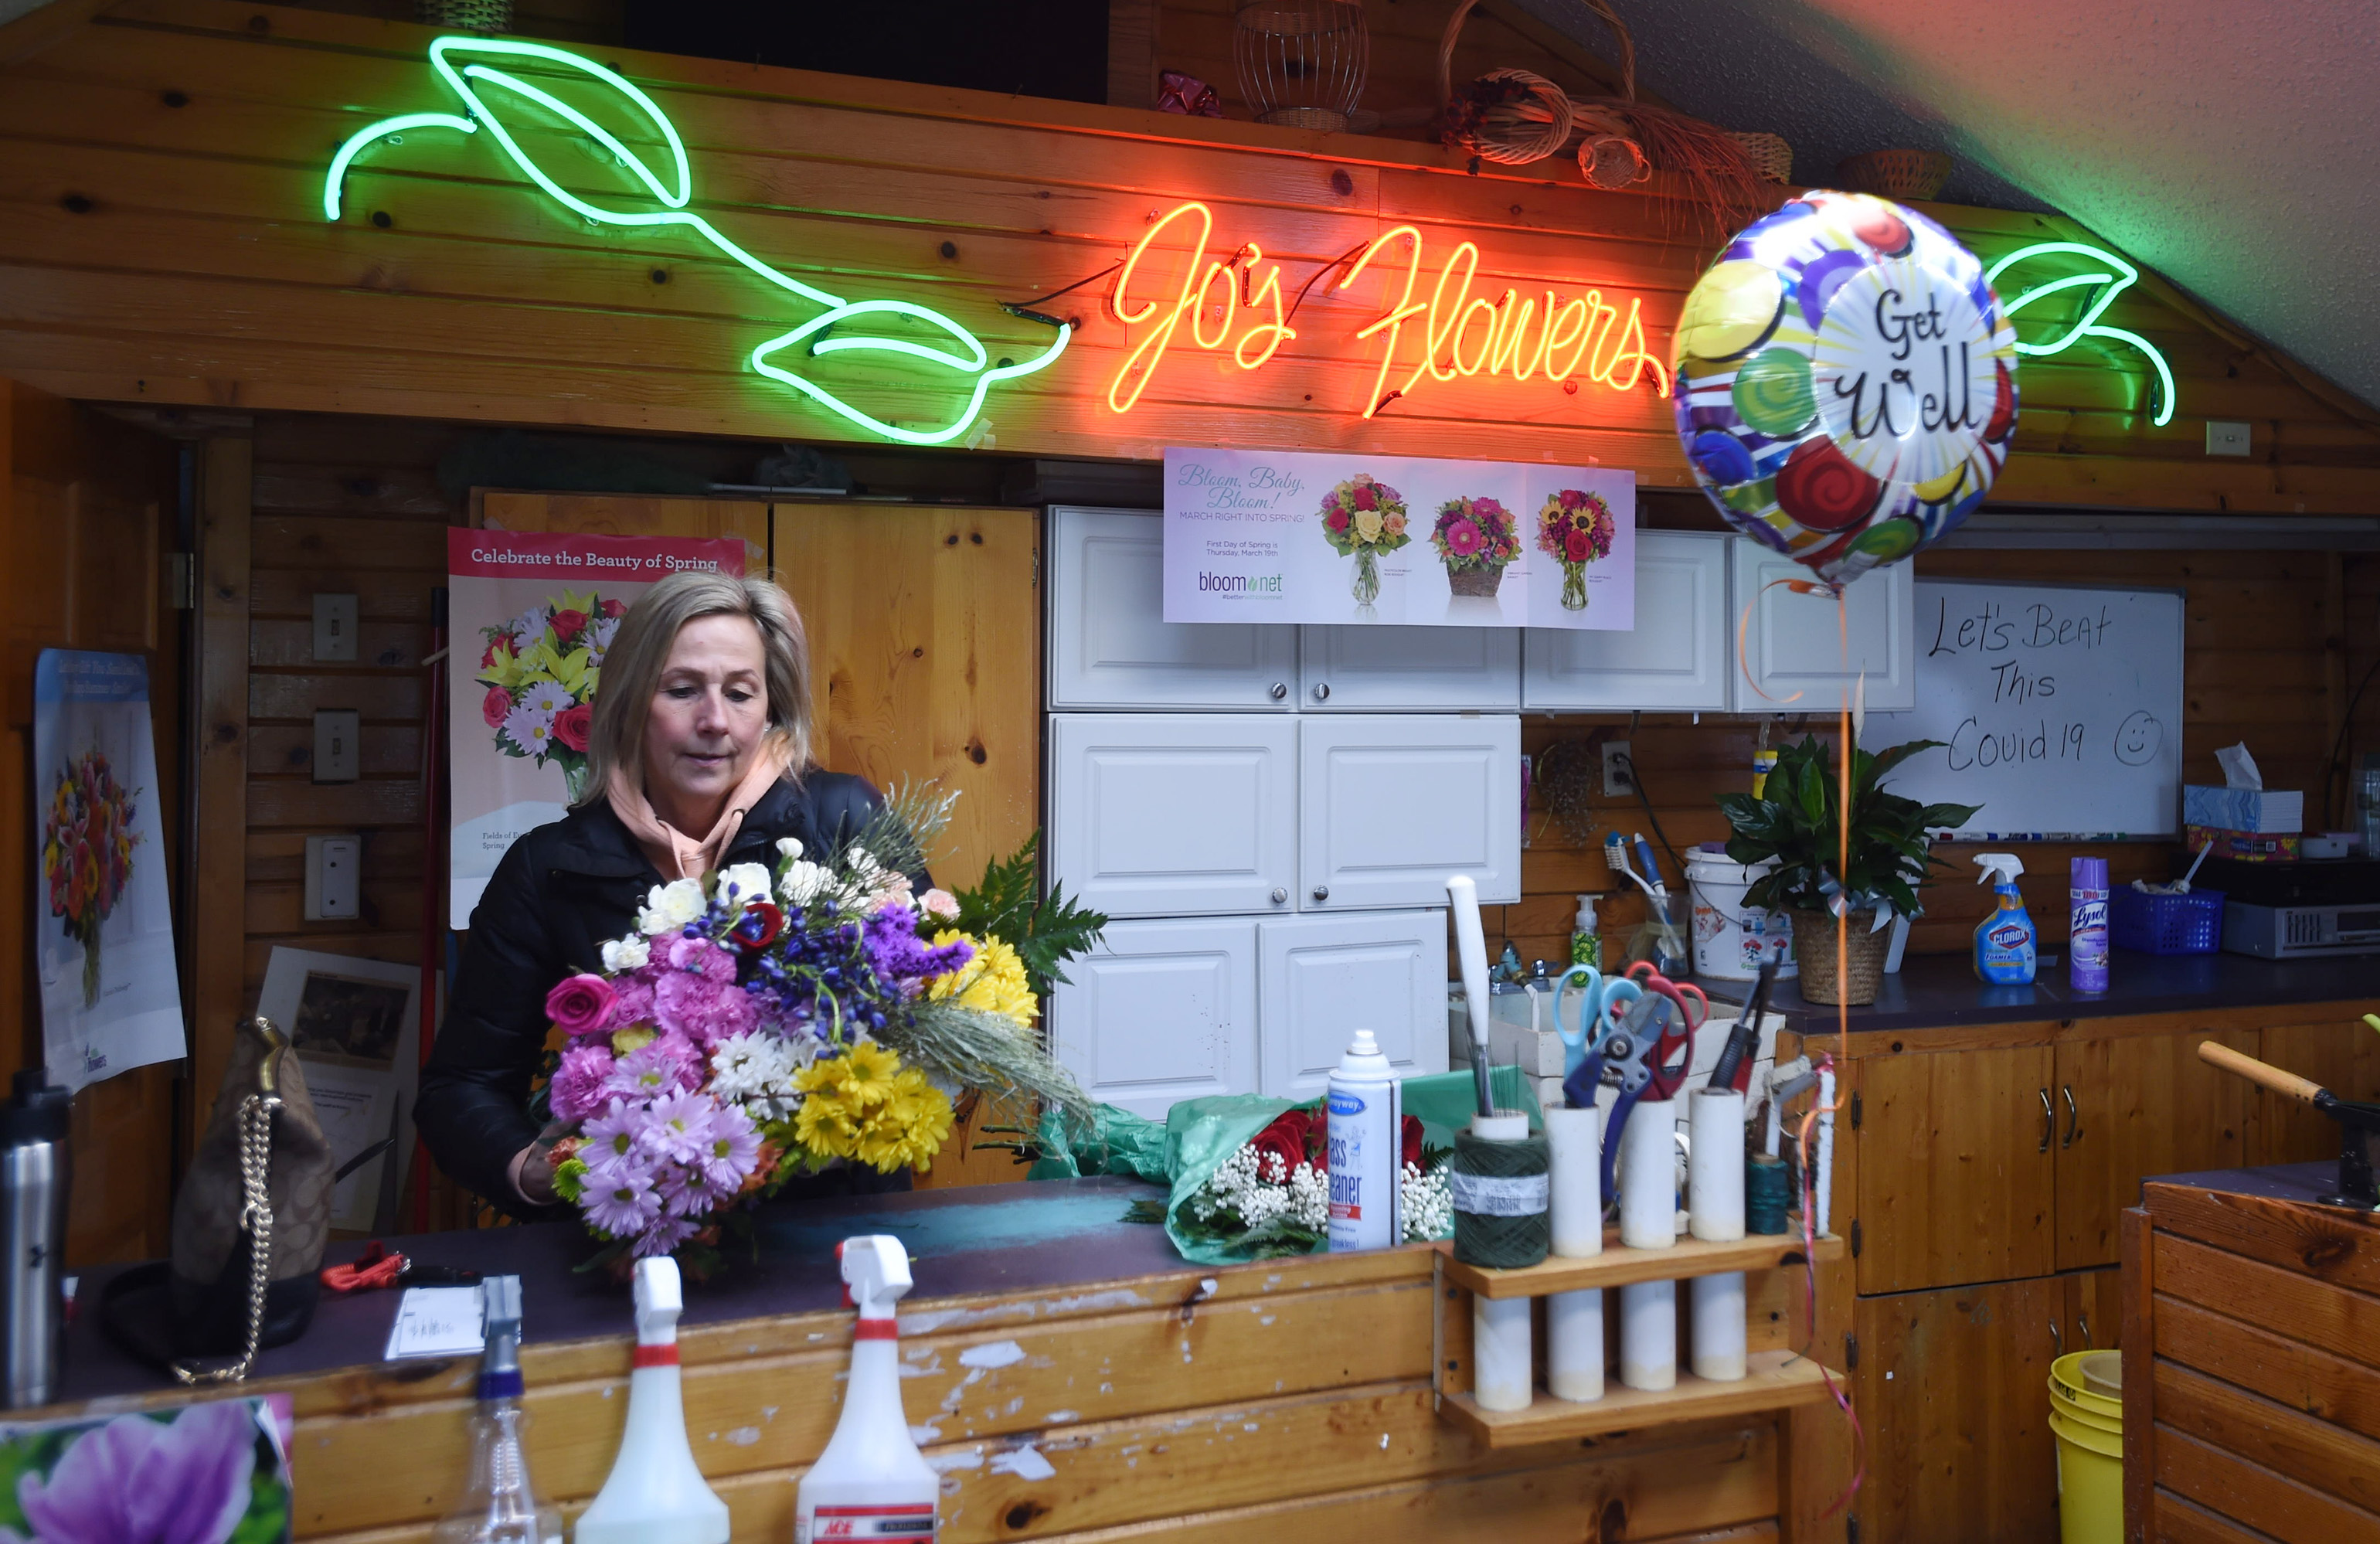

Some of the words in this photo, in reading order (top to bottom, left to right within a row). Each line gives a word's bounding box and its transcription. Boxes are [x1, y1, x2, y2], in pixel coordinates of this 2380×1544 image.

[1108, 201, 1296, 413] Jo's
[1340, 225, 1670, 419] Flowers
[1875, 288, 1946, 361] Get
[1834, 341, 1983, 440] Well
[1206, 486, 1281, 508] Bloom!
[1179, 512, 1213, 521] MARCH
[1216, 512, 1243, 521] RIGHT
[1245, 513, 1267, 522] INTO
[1270, 514, 1305, 523] SPRING!
[471, 549, 551, 565] Celebrate
[555, 551, 582, 566] the
[586, 553, 642, 570] Beauty
[645, 554, 662, 568] of
[665, 556, 718, 572] Spring
[1928, 597, 2014, 657] Let's
[1991, 659, 2055, 705] This
[2061, 723, 2085, 760] 19
[2073, 903, 2106, 928] Lysol
[1994, 930, 2027, 944] CLOROX
[823, 1519, 855, 1535] ACE
